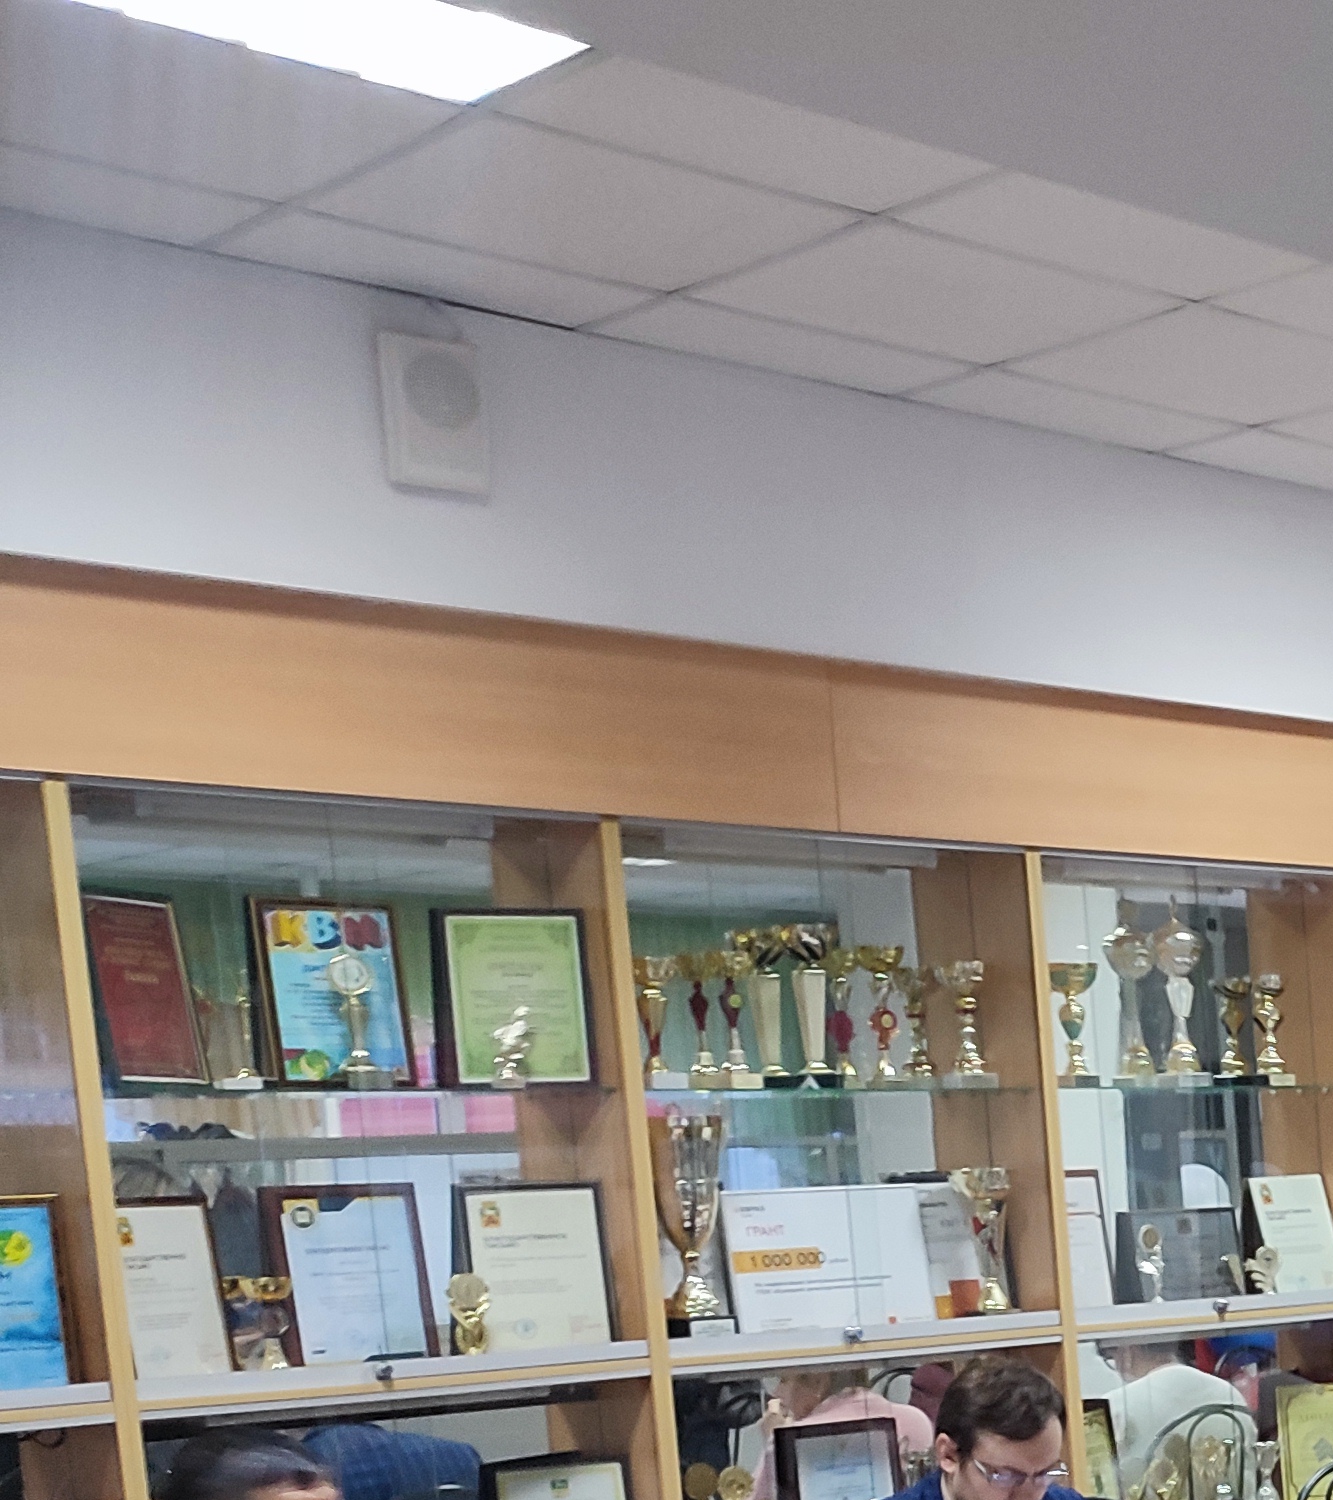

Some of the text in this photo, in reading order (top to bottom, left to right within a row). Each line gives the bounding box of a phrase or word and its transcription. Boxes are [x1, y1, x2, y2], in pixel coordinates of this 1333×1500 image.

[745, 1224, 786, 1236] ГРАНТ
[761, 1254, 793, 1267] 000
[797, 1251, 827, 1265] 000
